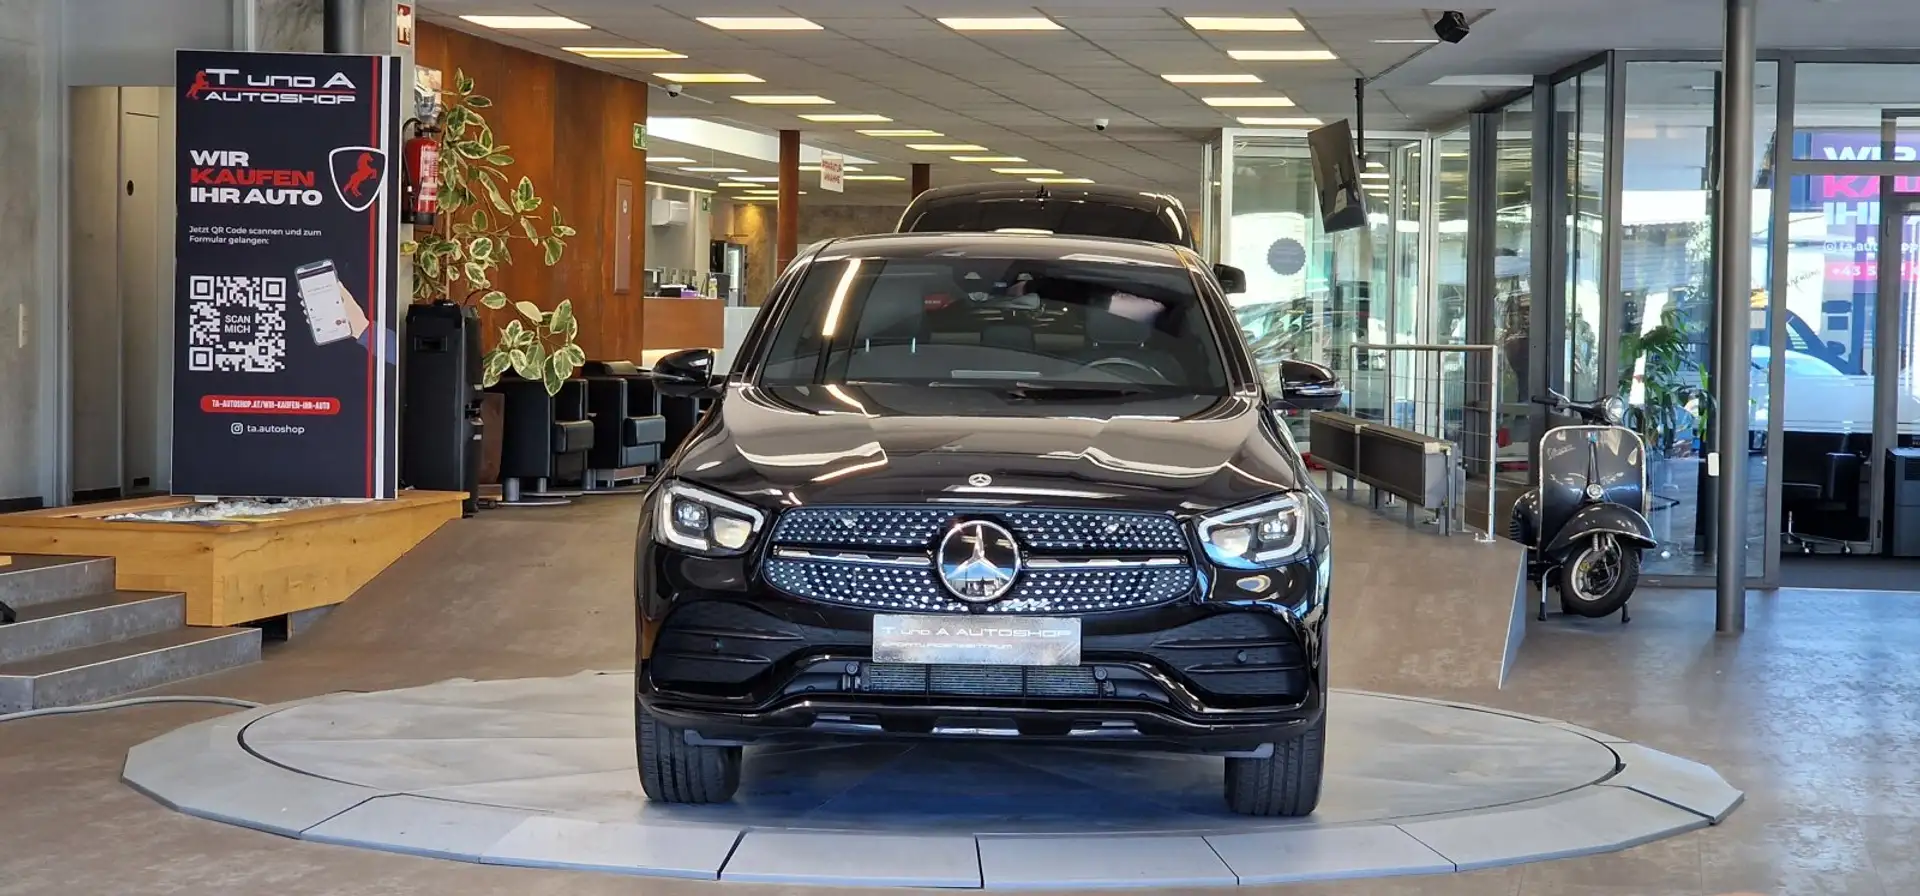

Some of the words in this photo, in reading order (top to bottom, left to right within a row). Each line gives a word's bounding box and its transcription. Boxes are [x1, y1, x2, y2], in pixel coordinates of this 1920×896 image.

[205, 68, 239, 85] T
[322, 72, 356, 89] A
[205, 91, 356, 104] AUTOSHOP
[190, 150, 249, 167] WIR
[190, 168, 315, 187] KAUFEN
[190, 187, 241, 204] IHR
[243, 189, 323, 206] AUTO
[211, 226, 224, 235] QR
[225, 226, 247, 234] Code
[285, 228, 301, 236] und
[189, 235, 226, 243] Formular
[228, 236, 270, 246] gelangen:
[224, 315, 251, 323] SCAN
[224, 325, 251, 334] MICH
[247, 424, 305, 435] ta.autoshop
[881, 626, 897, 635] T
[935, 627, 951, 636] A
[956, 627, 1072, 638] AUTOSHOP
